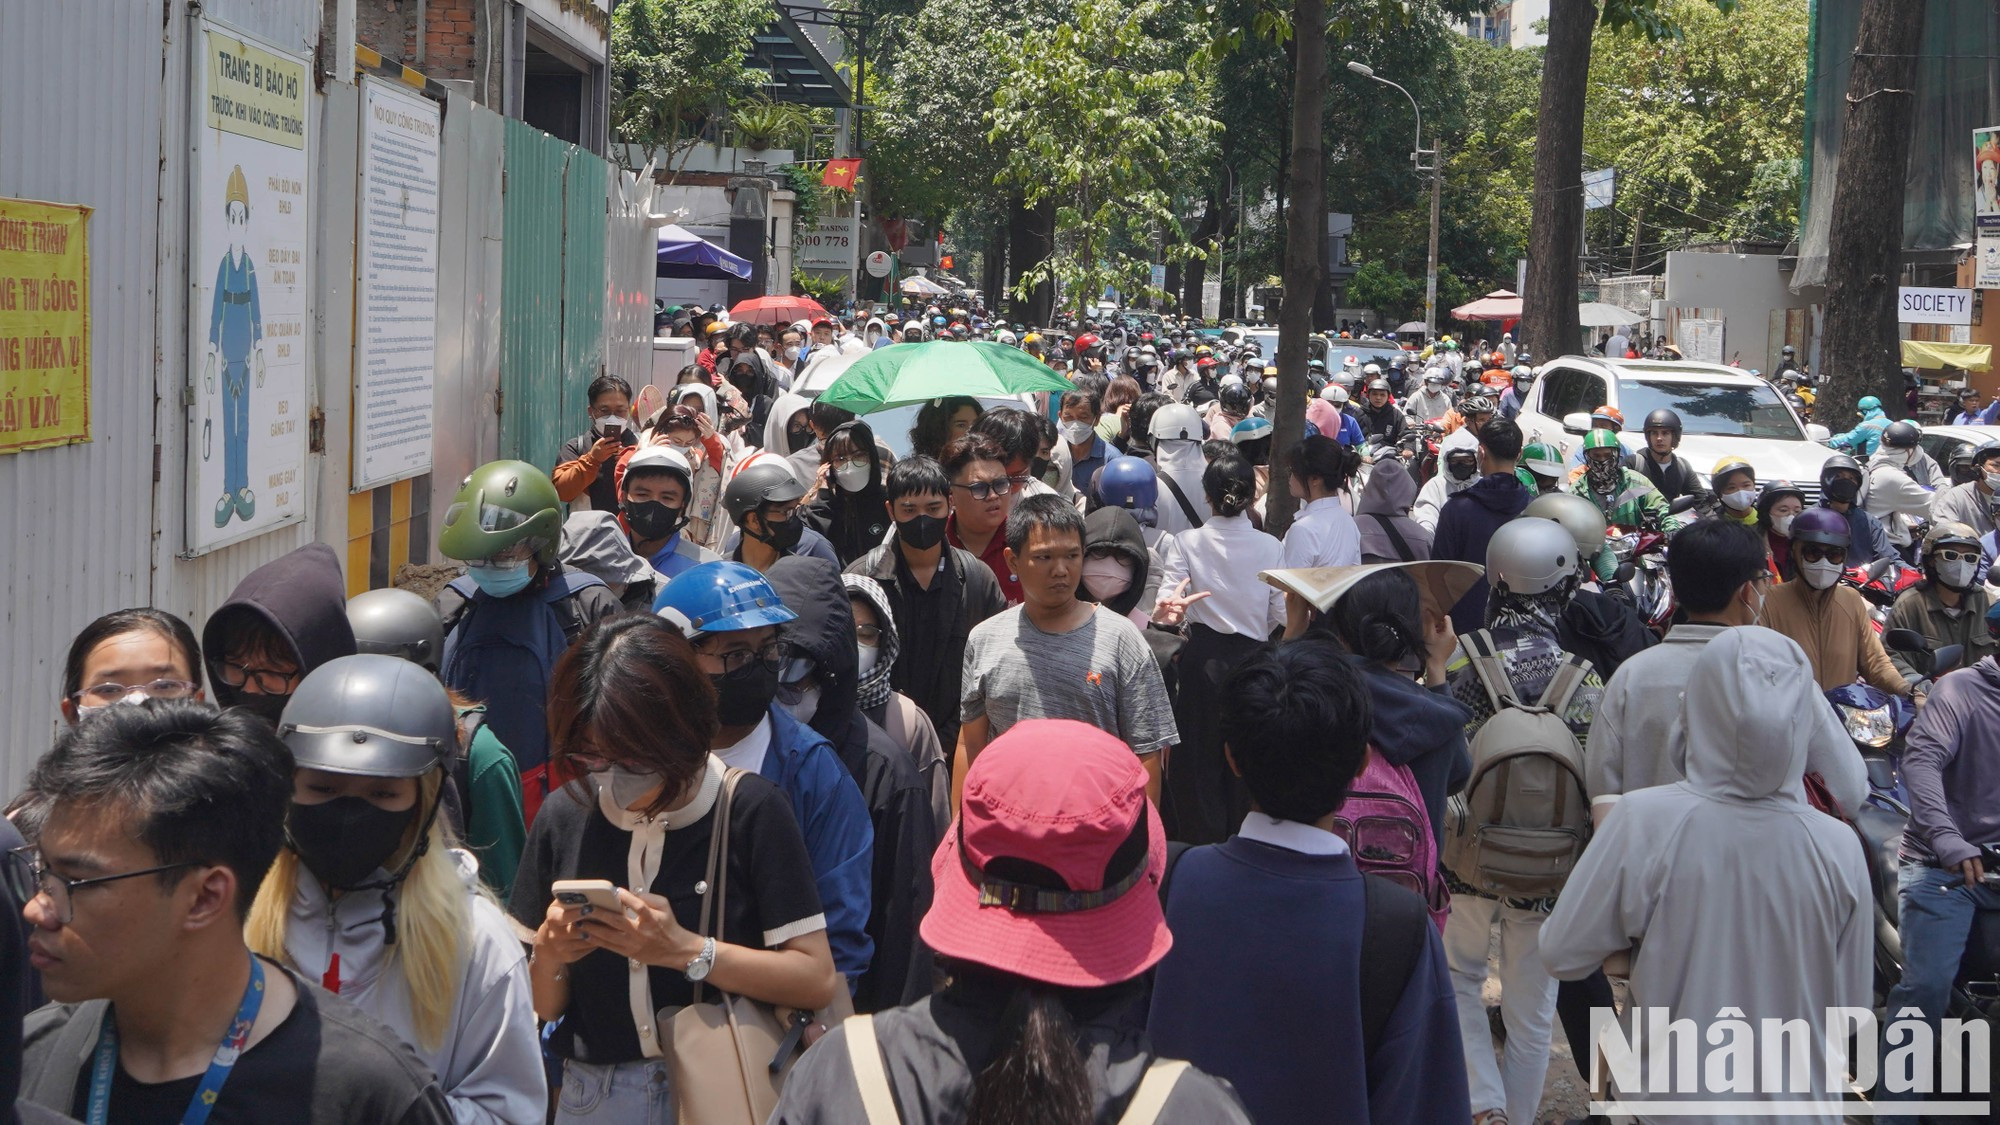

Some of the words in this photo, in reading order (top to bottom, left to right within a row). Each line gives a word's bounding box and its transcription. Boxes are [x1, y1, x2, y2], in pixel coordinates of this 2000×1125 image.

[219, 51, 251, 85] TRANG
[254, 63, 263, 96] BỊ
[266, 62, 283, 96] BẢO
[286, 72, 298, 107] HỘ
[211, 94, 234, 117] TRƯỚC
[235, 101, 247, 121] KHI
[248, 102, 262, 125] VÀO
[263, 108, 279, 130] CÔNG
[280, 115, 303, 136] TRƯỜNG
[398, 112, 414, 131] CÔNG
[414, 118, 435, 138] TRƯỜNG
[31, 215, 69, 255] TRÌNH
[824, 236, 849, 247] 778
[21, 277, 40, 311] THI
[1903, 293, 1966, 312] SOCIETY
